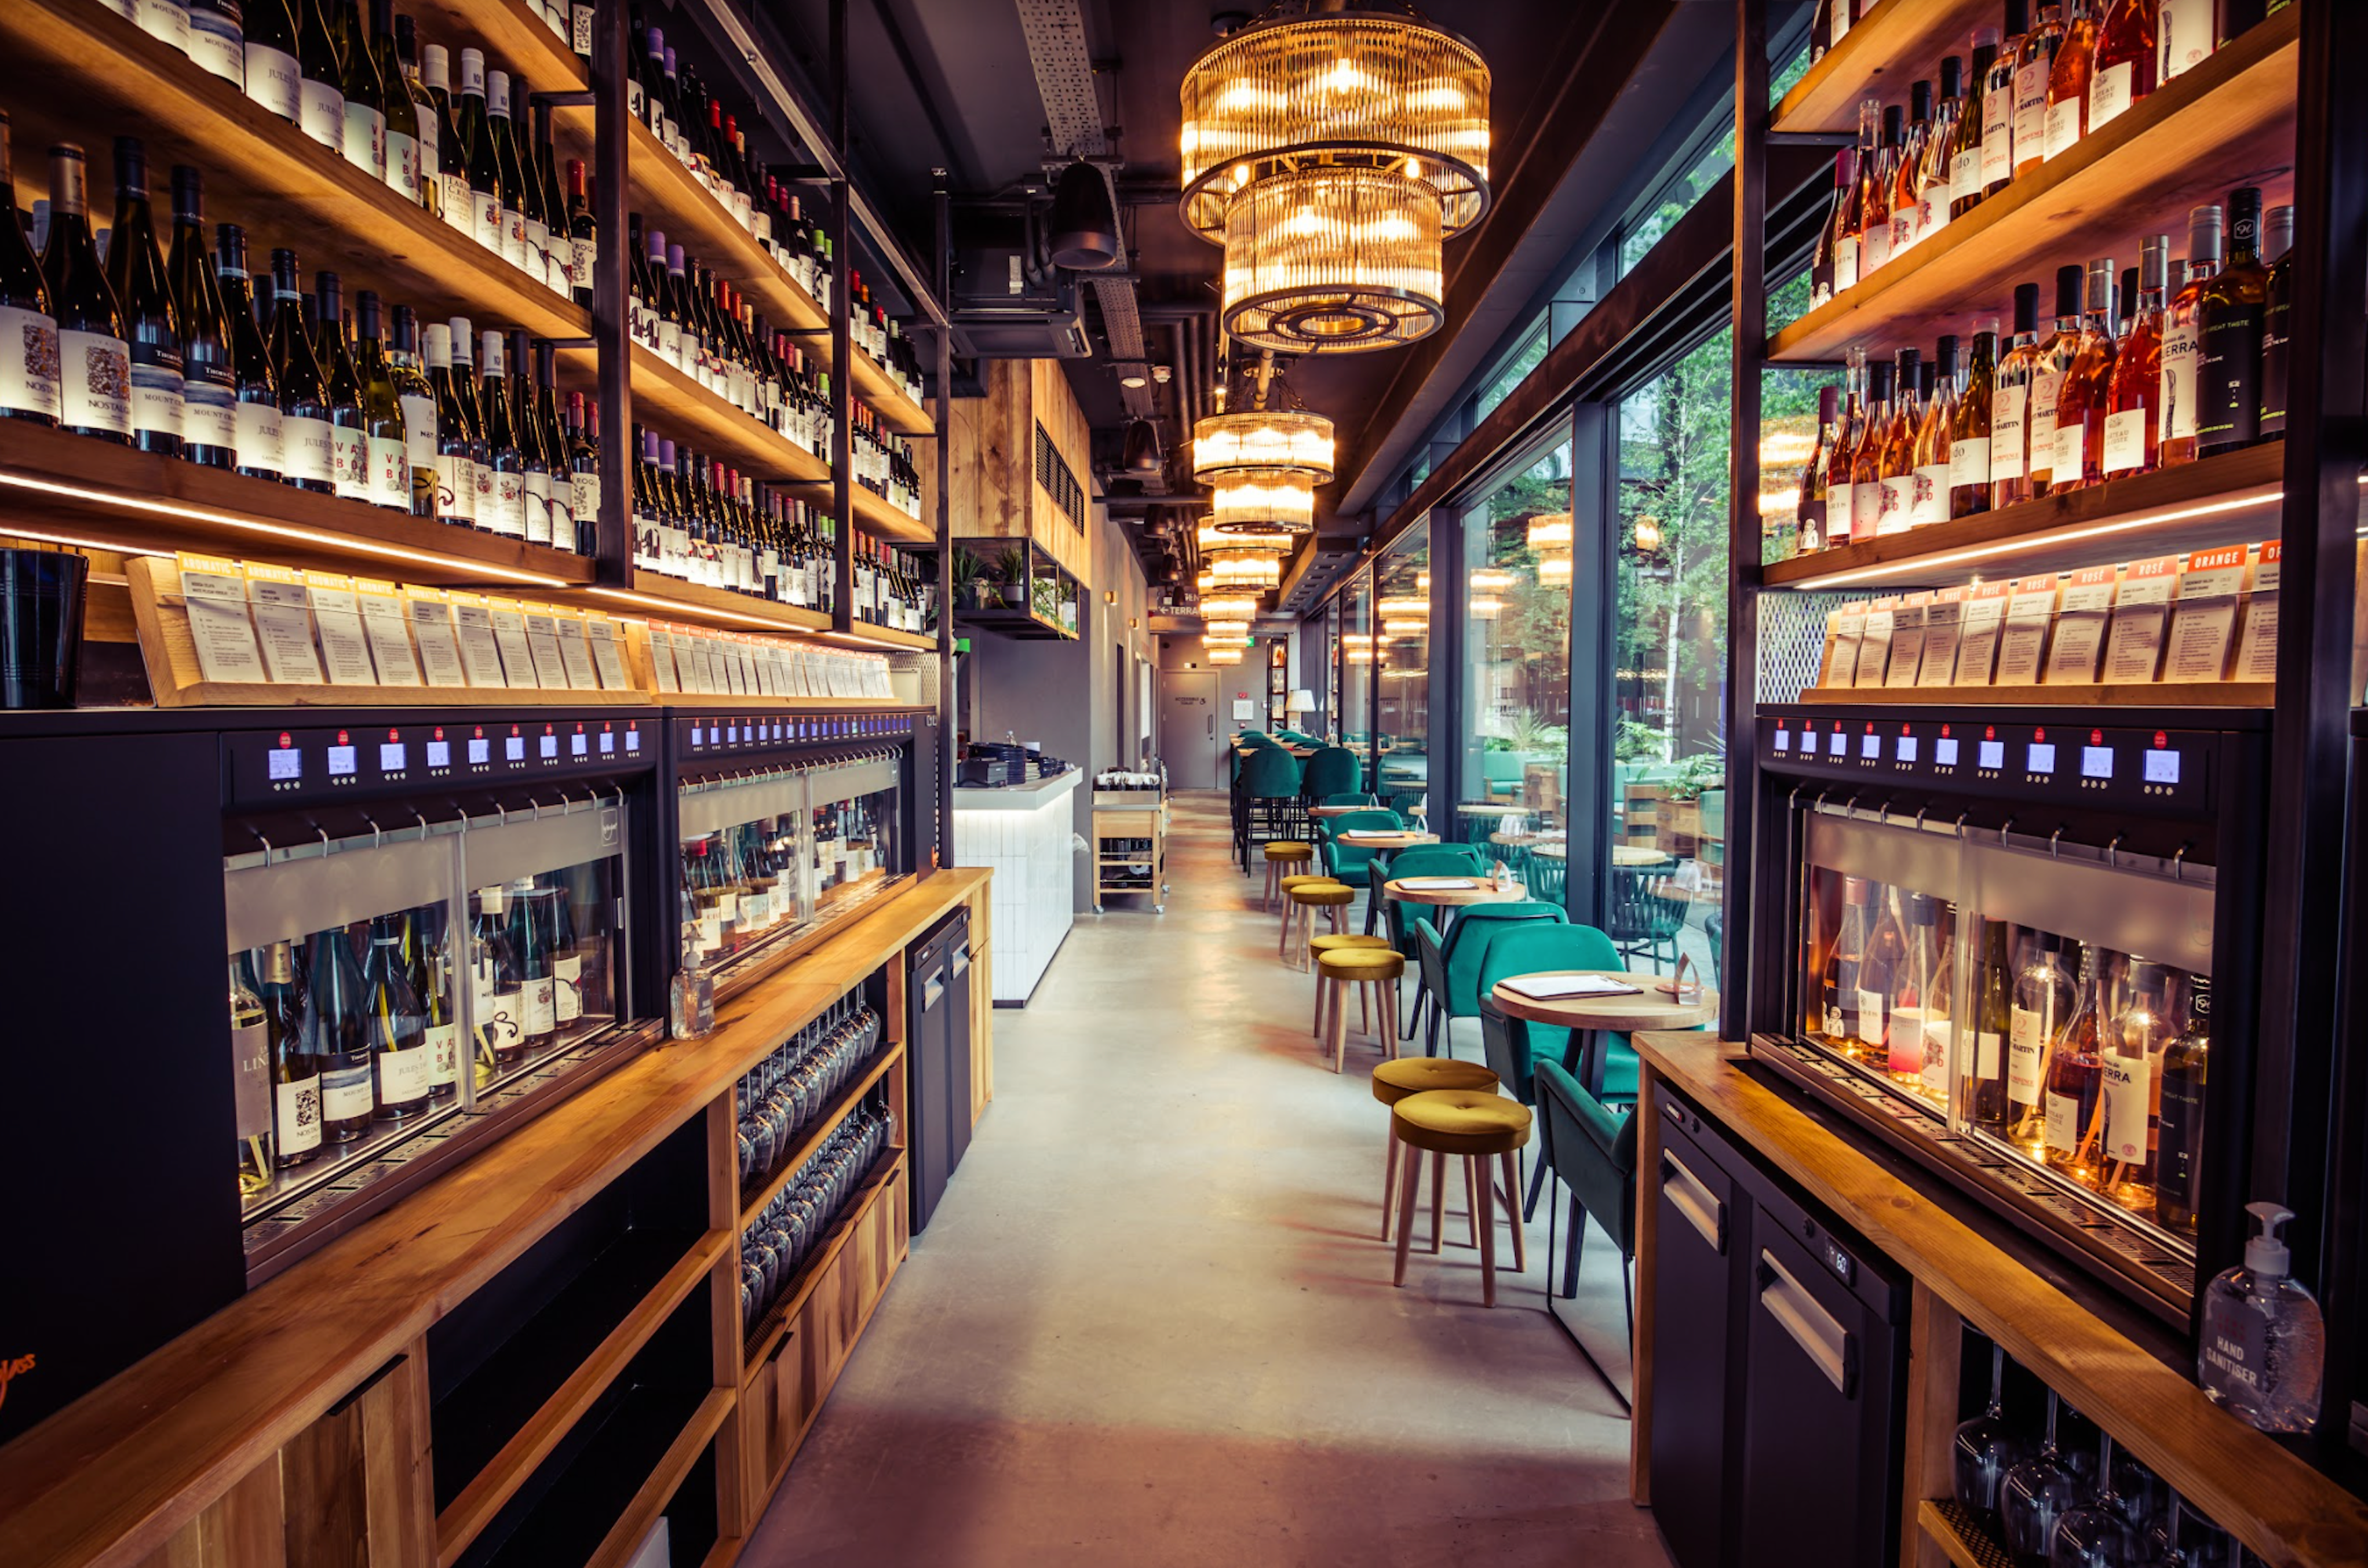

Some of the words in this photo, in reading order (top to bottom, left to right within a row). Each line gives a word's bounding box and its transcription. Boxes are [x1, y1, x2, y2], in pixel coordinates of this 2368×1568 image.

[2163, 340, 2198, 359] ERRA
[194, 409, 222, 419] MOUNT
[1996, 420, 2020, 431] MARTIN
[183, 556, 231, 574] AROMATIC
[2194, 551, 2239, 569] ORANGE
[248, 565, 291, 581] AROMATIC
[2081, 569, 2104, 584] ROSÉ
[2138, 561, 2165, 577] ROSÉ
[308, 574, 346, 589] AROMATIC
[358, 581, 393, 595] AROMATIC
[2027, 578, 2046, 591] ROSÉ
[407, 588, 439, 601] AROMATIC
[1944, 589, 1961, 601] ROSÉ
[1982, 583, 2000, 596] ROSÉ
[1910, 594, 1926, 607] ROSÉ
[2217, 1335, 2245, 1362] HAND
[2205, 1347, 2258, 1387] SANITISER
